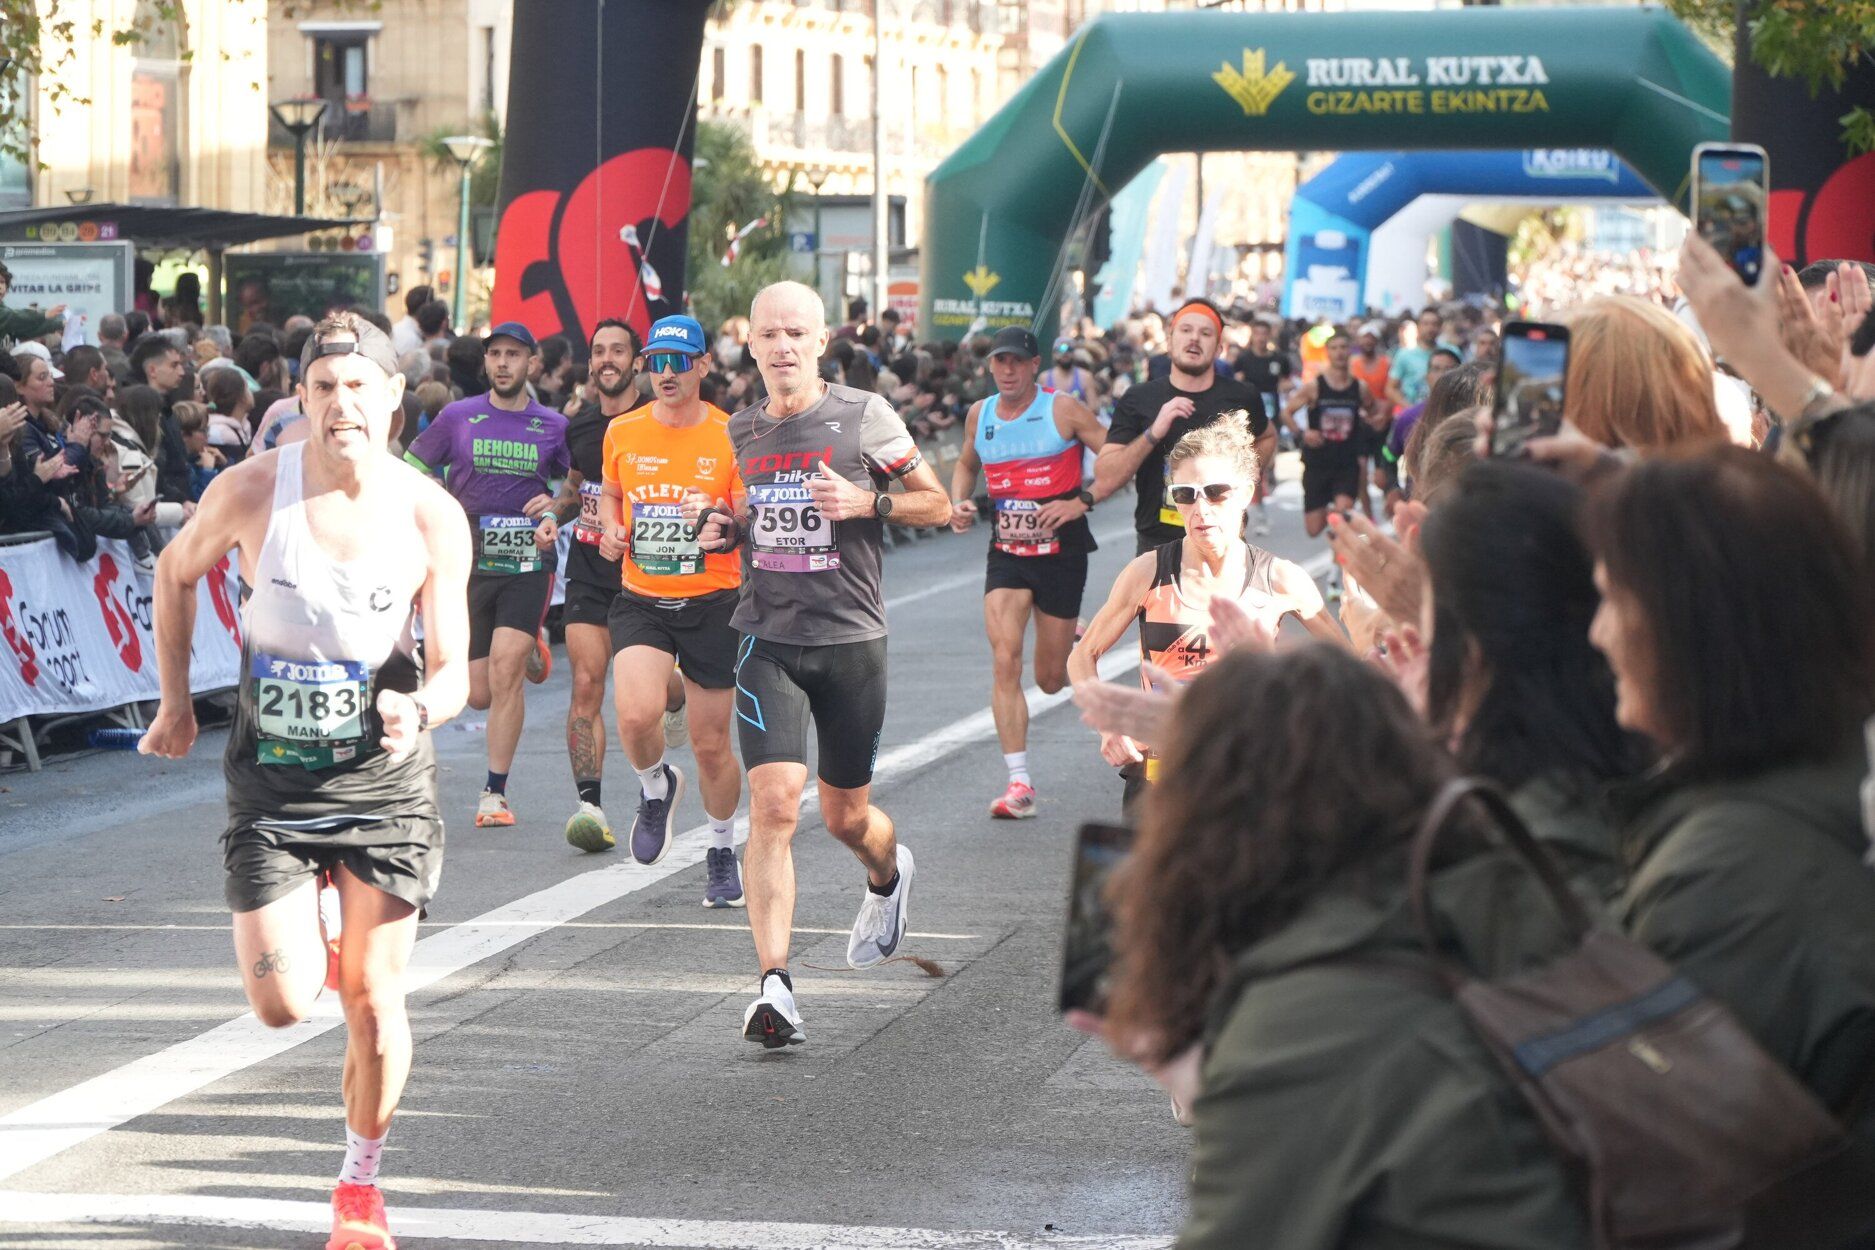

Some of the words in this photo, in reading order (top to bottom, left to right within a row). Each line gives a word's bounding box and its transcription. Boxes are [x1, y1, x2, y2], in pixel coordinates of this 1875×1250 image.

[1307, 58, 1419, 86] RURAL
[1426, 56, 1549, 85] KUTXA
[1307, 91, 1423, 114] GIZARTE
[1431, 89, 1549, 113] EKINTZA
[10, 285, 45, 294] VITAR
[49, 285, 62, 293] LA
[933, 298, 977, 315] RURAL
[981, 302, 1034, 316] KUTXA
[655, 327, 688, 340] HOKA
[473, 438, 539, 461] BEHOBIA
[473, 457, 491, 467] SAN
[627, 483, 689, 504] ATLET
[760, 506, 821, 533] 596
[1001, 512, 1043, 529] 379
[486, 530, 535, 547] 2453
[636, 521, 698, 543] 2229
[776, 537, 806, 546] ETOR
[1185, 633, 1211, 659] 4
[261, 684, 357, 721] 2183
[287, 725, 330, 738] MANU
